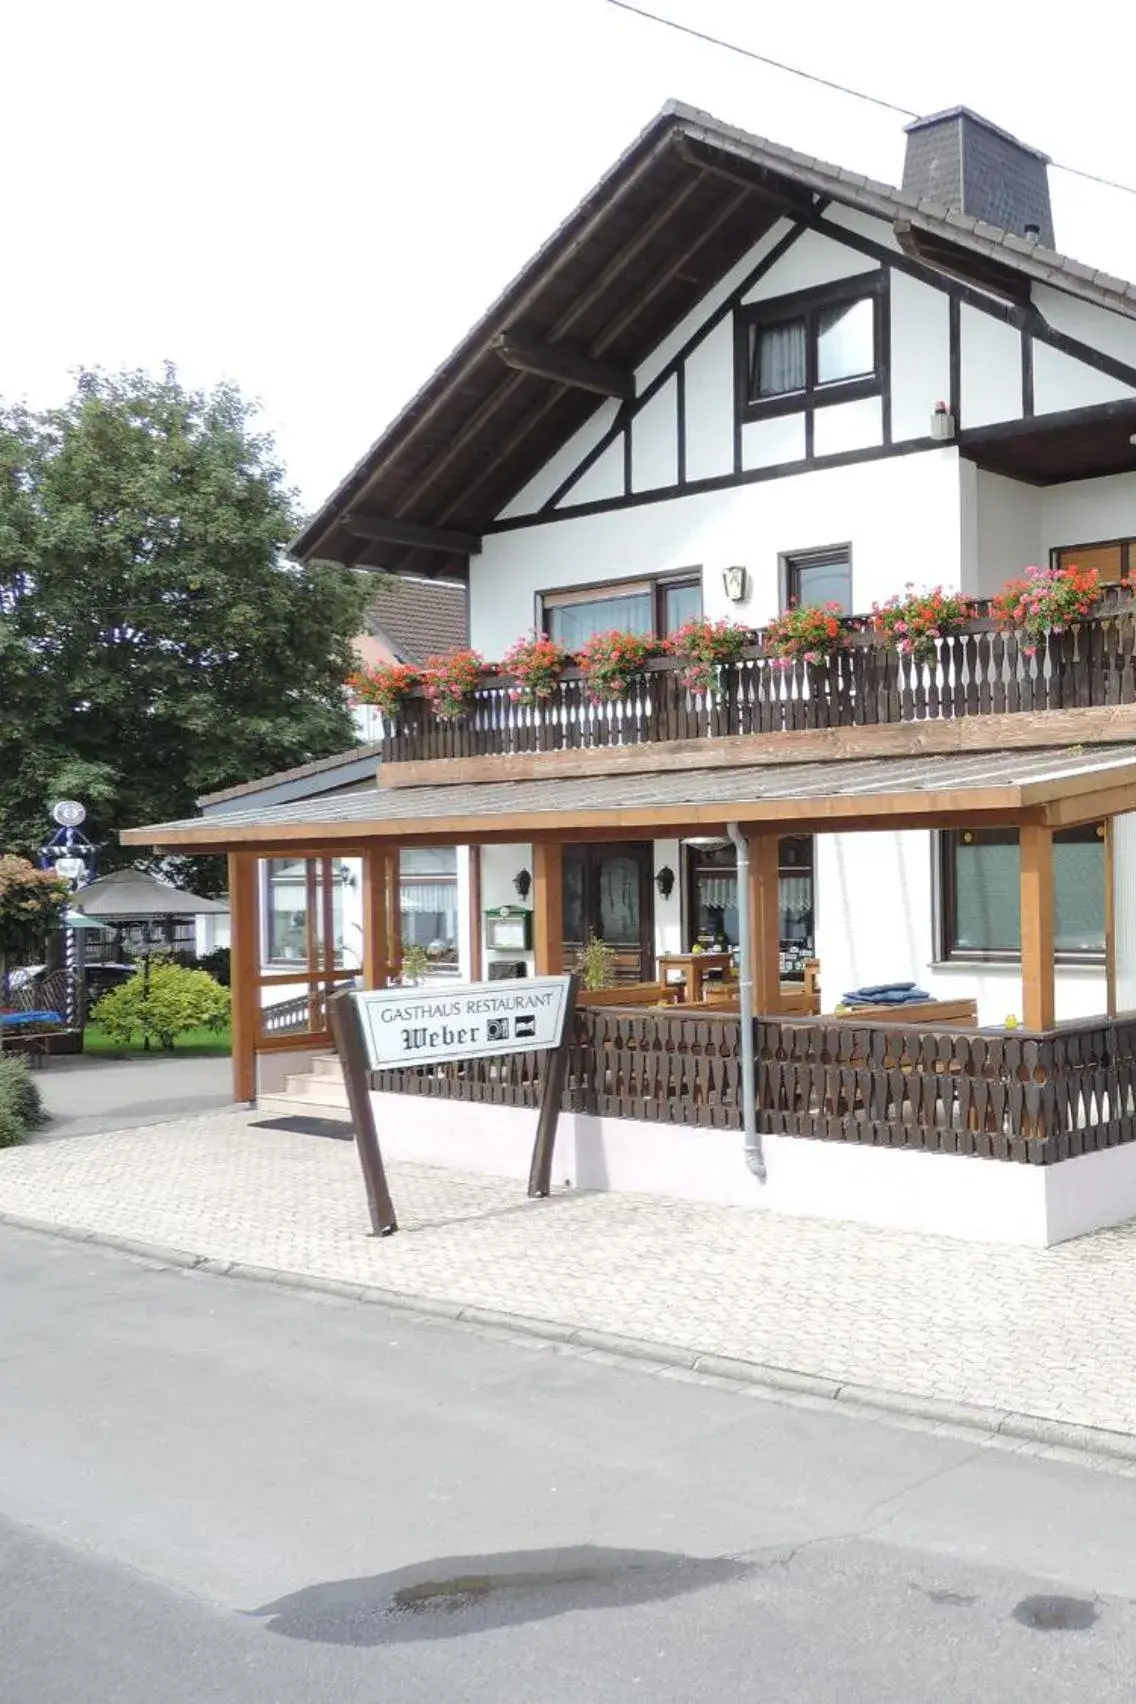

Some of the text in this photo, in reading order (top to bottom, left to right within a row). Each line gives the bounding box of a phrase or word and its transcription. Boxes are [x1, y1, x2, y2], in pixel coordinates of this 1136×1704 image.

[381, 993, 554, 1023] GASTHAUS RESTAURANT
[401, 1025, 480, 1050] Weber
